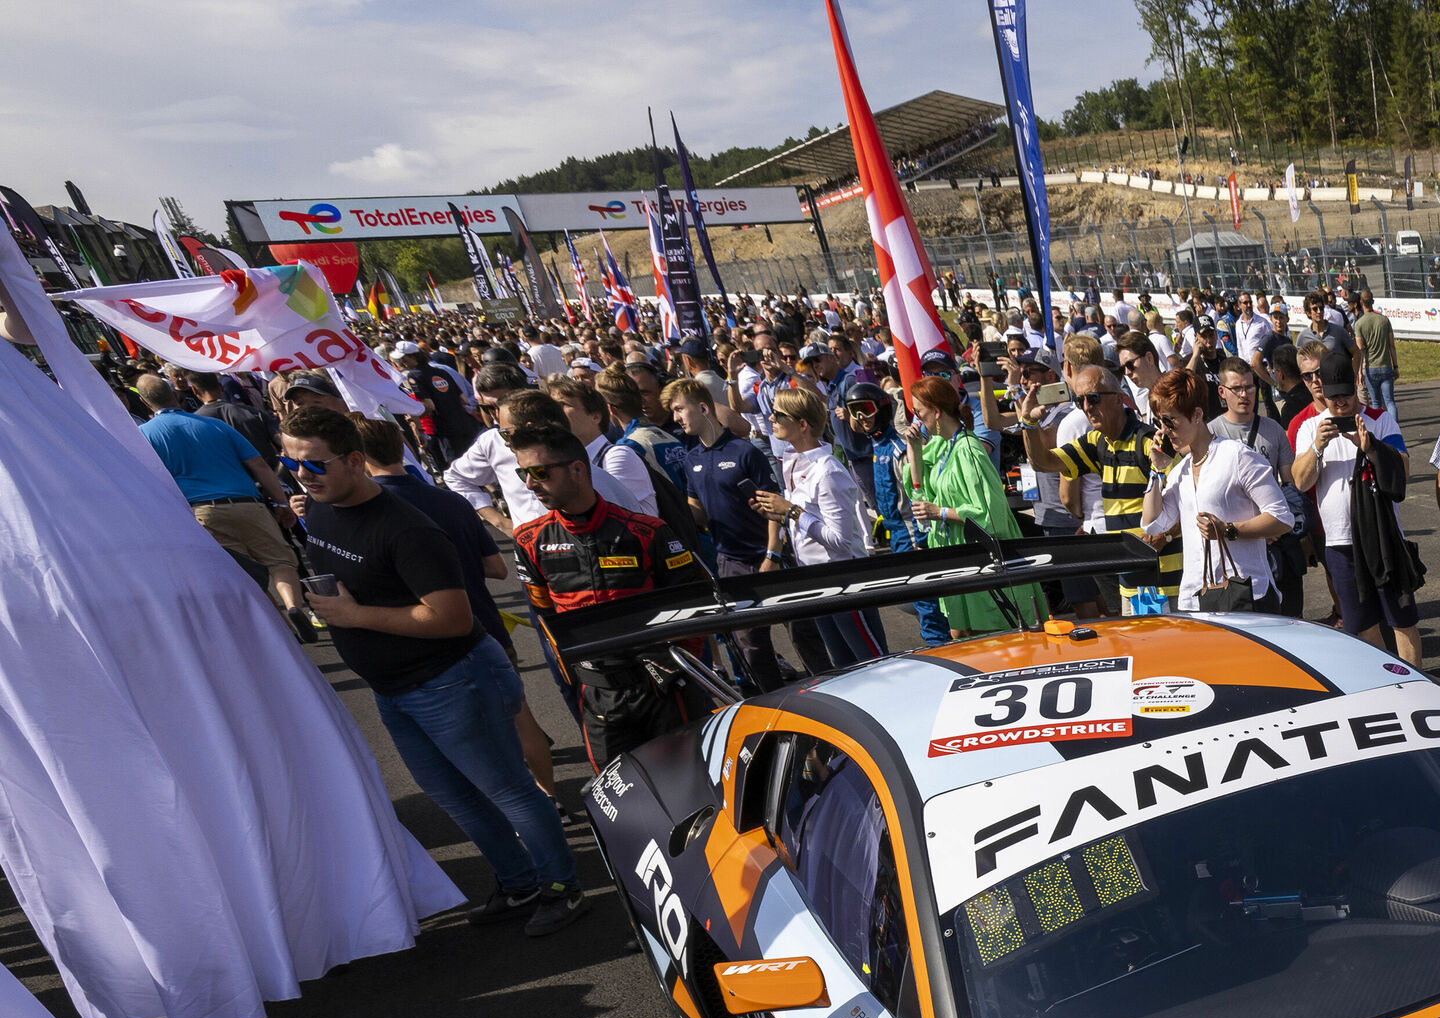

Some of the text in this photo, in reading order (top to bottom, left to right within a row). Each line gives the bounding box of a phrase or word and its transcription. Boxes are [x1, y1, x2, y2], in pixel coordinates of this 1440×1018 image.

[309, 255, 330, 266] udi
[326, 543, 364, 563] PROJECT
[974, 677, 1093, 727] 30
[945, 722, 1126, 749] CROWDSTRIKE
[721, 960, 808, 976] WRT
